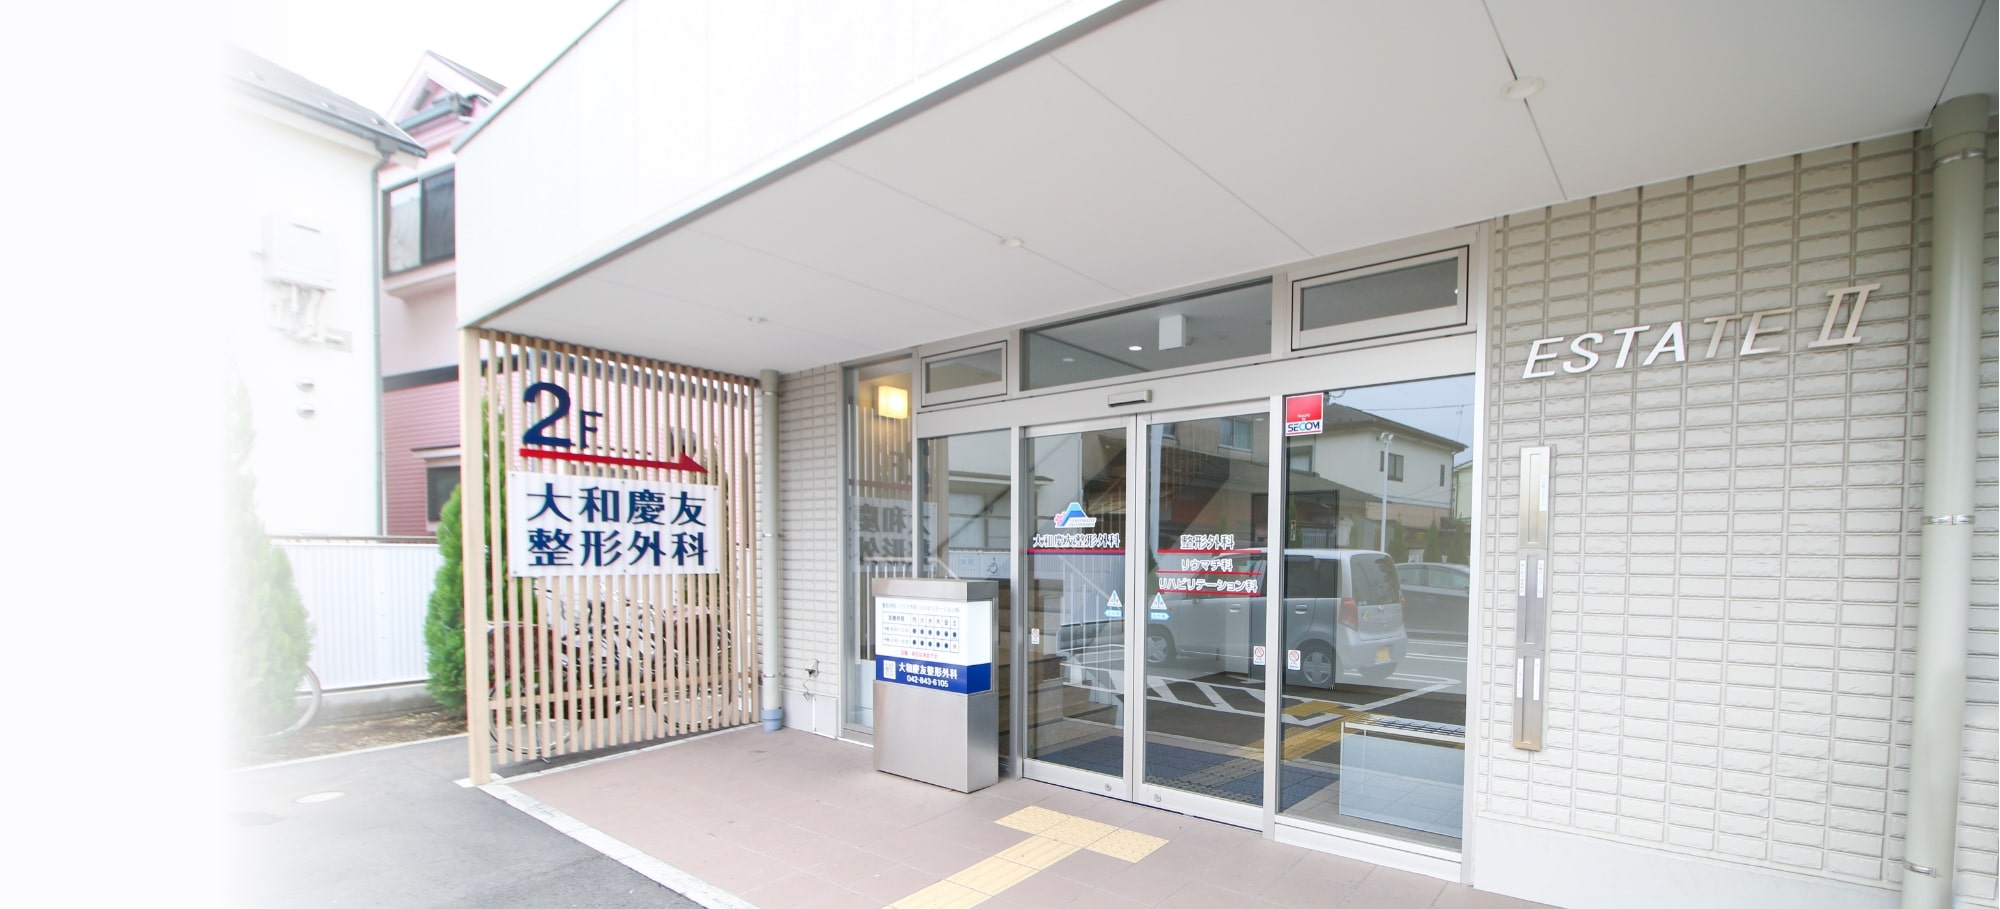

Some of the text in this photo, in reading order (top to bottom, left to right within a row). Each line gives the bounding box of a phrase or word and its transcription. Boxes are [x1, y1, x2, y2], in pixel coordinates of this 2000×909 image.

[1521, 307, 1793, 380] ESTATE
[522, 381, 603, 449] 2F
[1287, 421, 1320, 432] SECOM
[526, 482, 707, 527] 大和慶友
[527, 527, 709, 567] 整形外科
[1180, 534, 1235, 550] 整形外科
[1181, 558, 1233, 572] リウマチ科
[1158, 577, 1258, 593] リハビリテーション科
[906, 674, 949, 688] 042-843-6105
